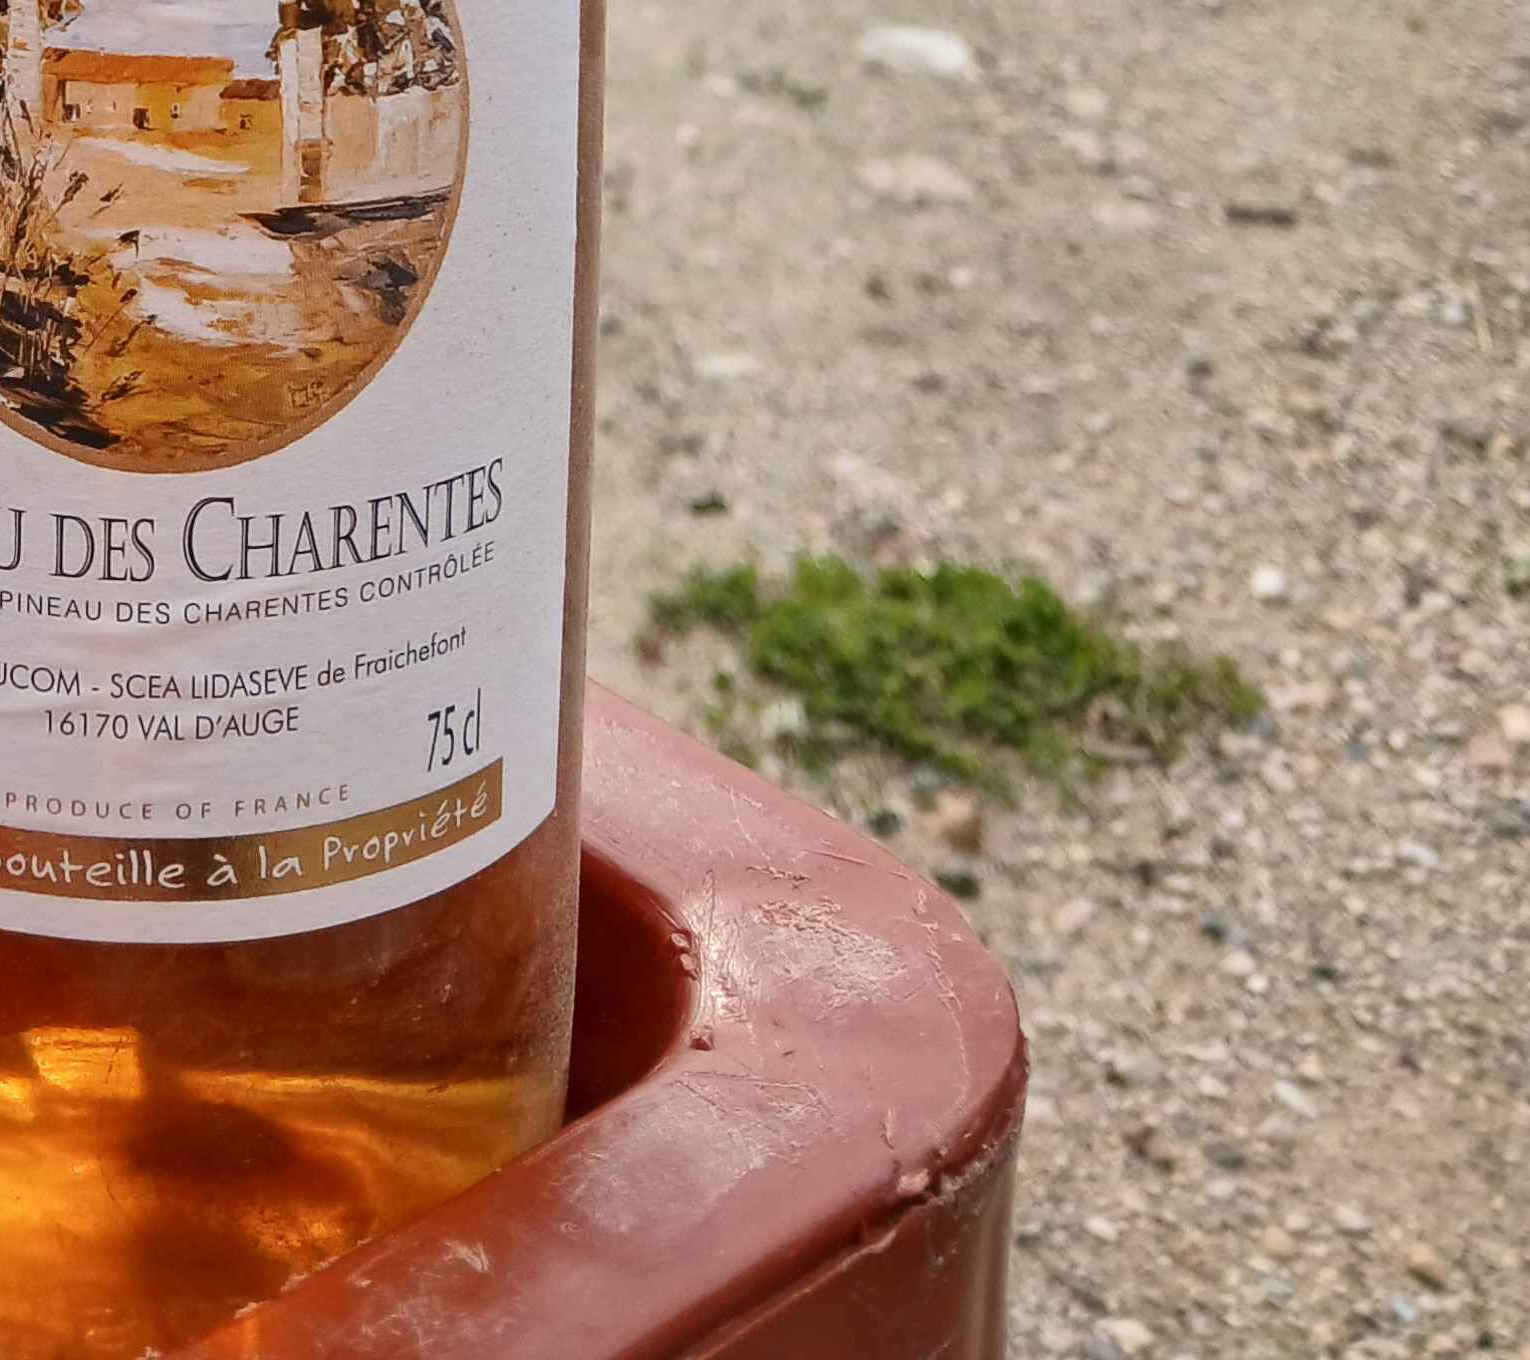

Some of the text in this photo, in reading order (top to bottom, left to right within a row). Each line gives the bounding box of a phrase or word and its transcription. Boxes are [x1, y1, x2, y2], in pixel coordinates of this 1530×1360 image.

[50, 513, 157, 583] DES
[181, 456, 505, 583] CHARENTES
[116, 601, 171, 625] DES
[183, 587, 349, 625] CHARENTES
[360, 540, 497, 603] CONTRÔLÉE
[110, 674, 182, 700] SCEA
[190, 664, 308, 700] LIDASEVE
[317, 659, 346, 688] de
[354, 625, 467, 680] Fraichefont
[44, 706, 300, 742] 16170 VAL D'AUGE
[426, 687, 482, 772] 75 cl
[5, 783, 350, 822] PRODUCE OF FRANCE
[206, 853, 239, 886] à
[258, 845, 304, 879] la
[323, 780, 489, 872] Propriété
